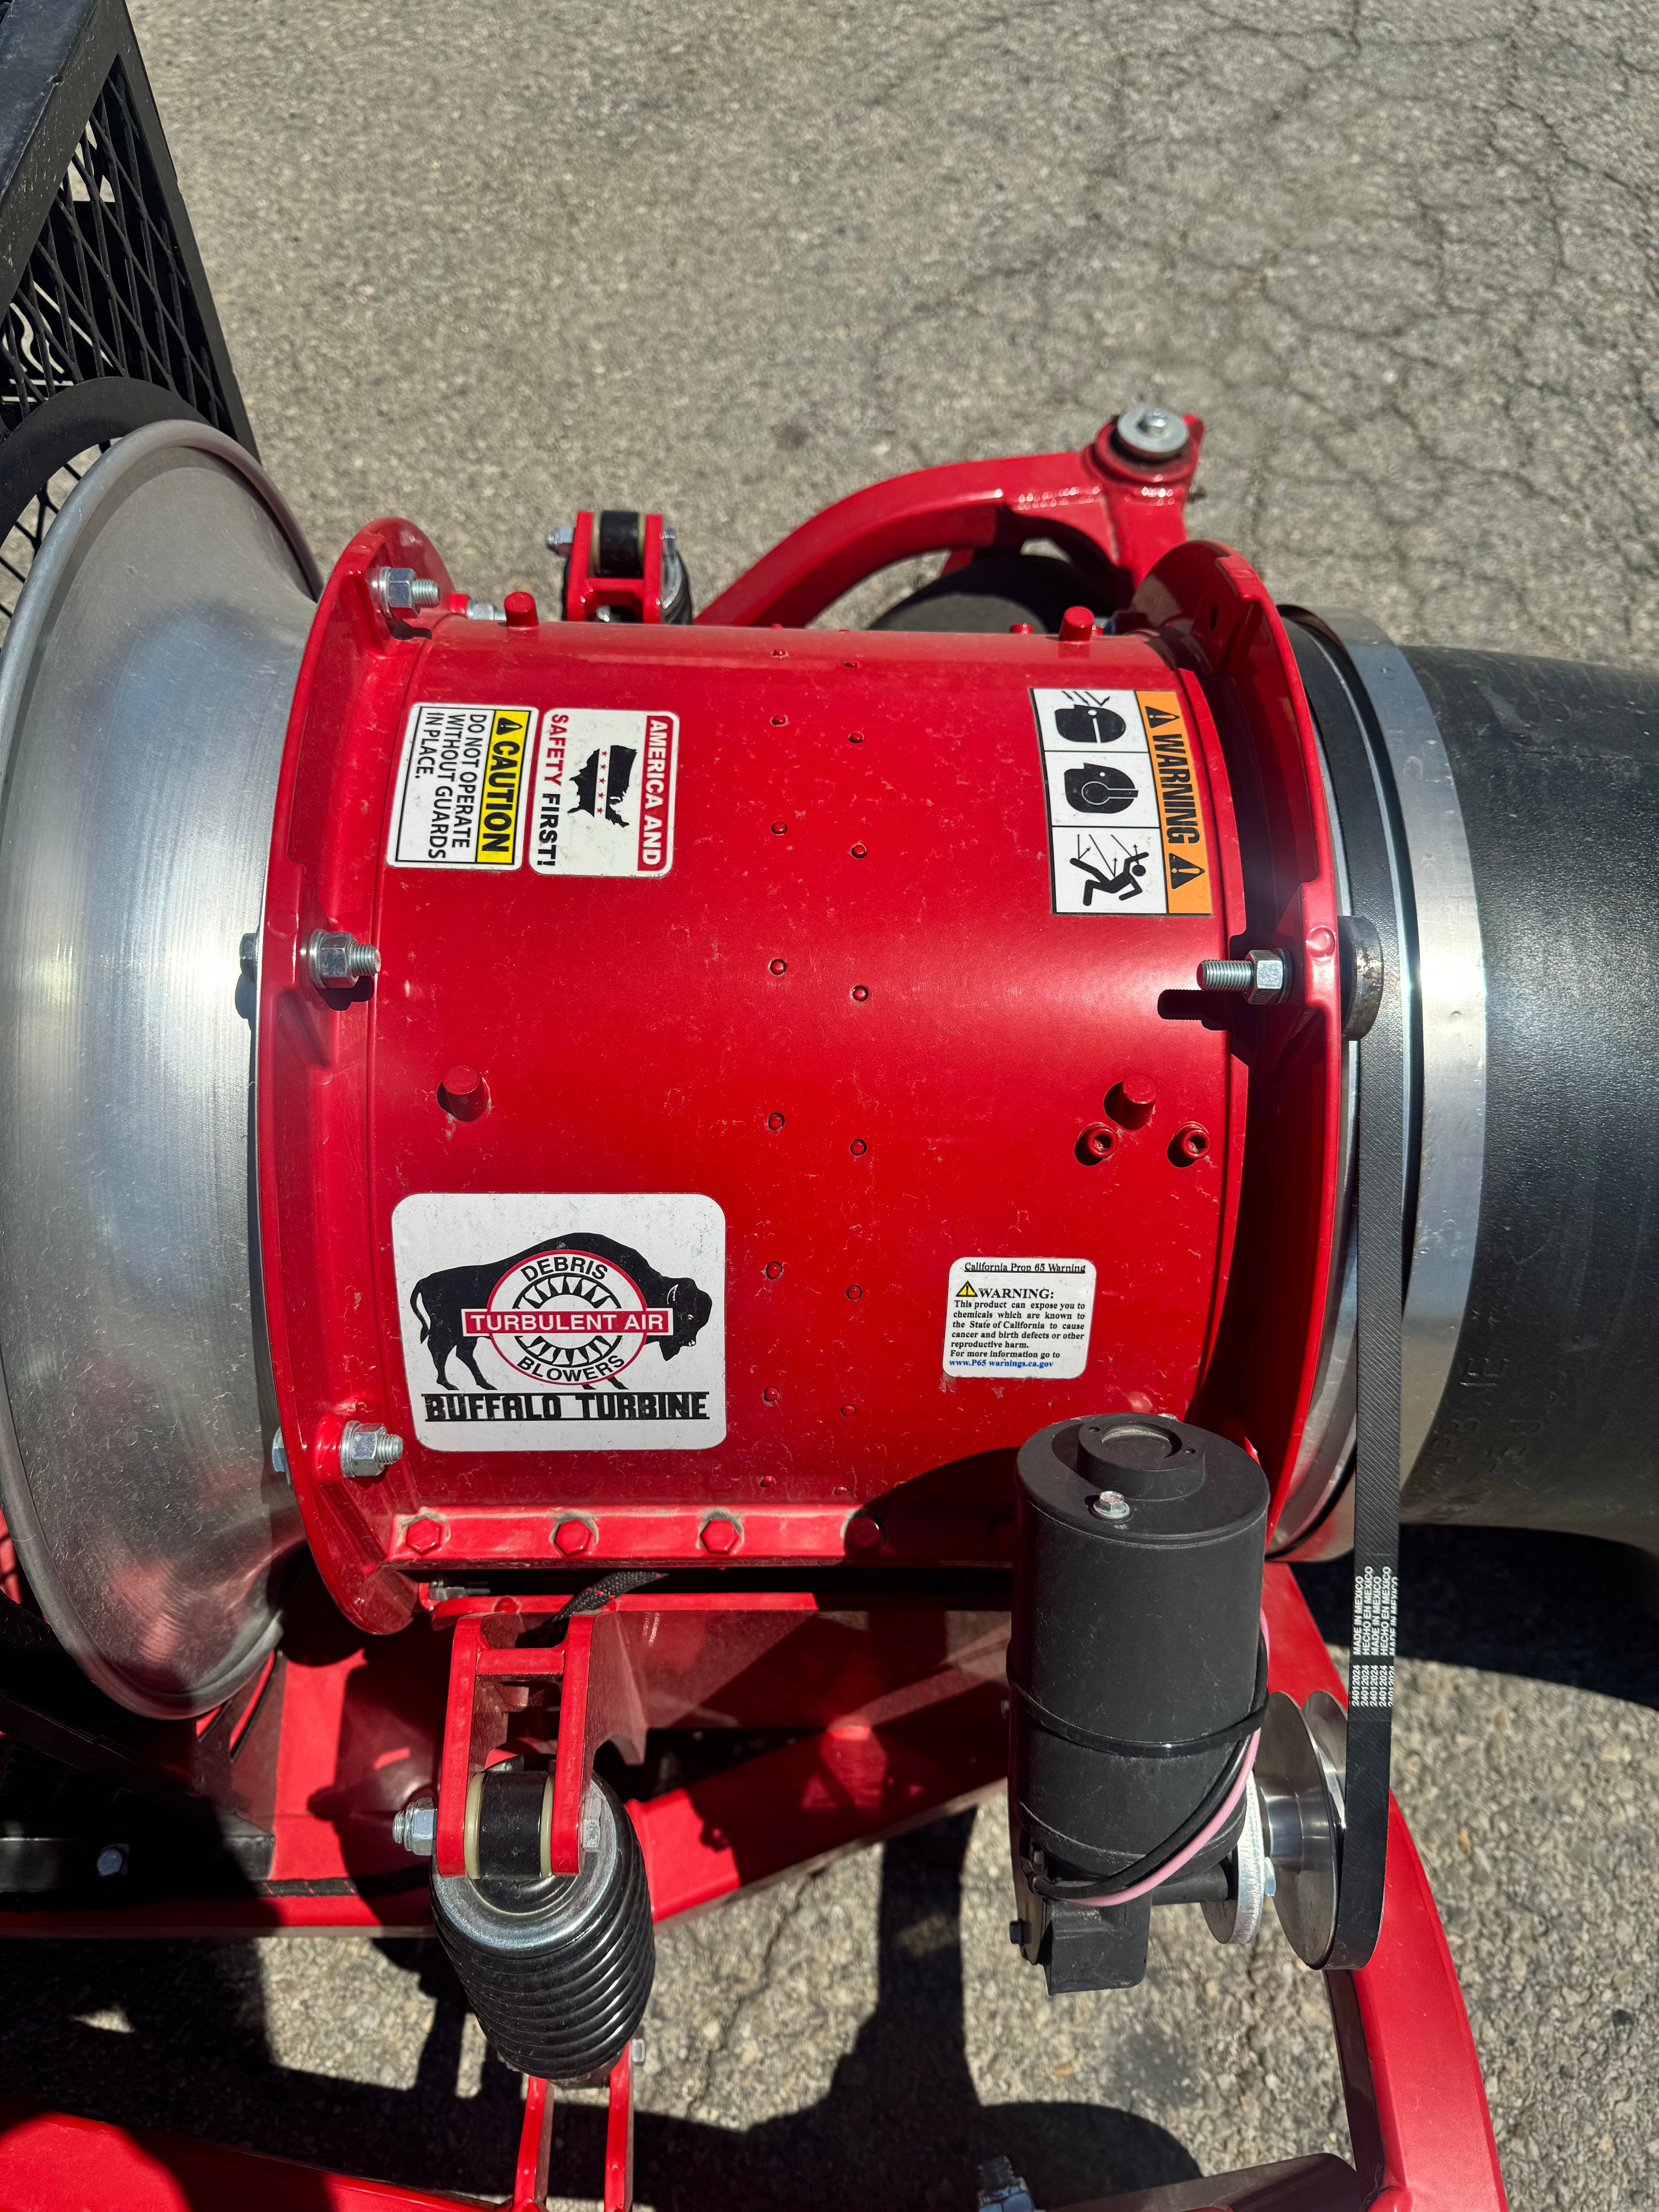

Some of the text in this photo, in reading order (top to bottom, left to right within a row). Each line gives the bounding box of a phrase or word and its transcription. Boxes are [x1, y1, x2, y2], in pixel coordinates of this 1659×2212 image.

[416, 713, 444, 778] IN PLACE.
[429, 715, 465, 858] WITHOUT GUARDS
[452, 715, 486, 847] DO NOT OPERATE
[482, 741, 520, 852] CAUTION
[537, 715, 569, 866] SAFETY FIRST!
[643, 720, 667, 864] AMERICA AND
[1153, 734, 1199, 843] WARNING
[521, 1256, 608, 1282] DEBRIS
[965, 1262, 1007, 1272] California
[1035, 1264, 1045, 1273] 65
[1048, 1264, 1086, 1274] Warning
[974, 1301, 1007, 1309] product
[979, 1288, 1053, 1298] WARNING:
[471, 1315, 663, 1330] TURBULENT AIR
[951, 1341, 1002, 1349] reproductive
[989, 1359, 1053, 1368] warnings.ca.gov
[517, 1356, 624, 1382] BLOWERS
[425, 1392, 710, 1420] BUFFALO TURBINE
[1353, 1576, 1364, 1656] MADE IN MEXICO
[1362, 1566, 1373, 1656] HECHO EN MEXICO
[1371, 1576, 1381, 1656] MADE IN MEXICO
[1380, 1566, 1392, 1656] HECHO EN MEXICO
[1351, 1665, 1360, 1707] 24012024
[1360, 1665, 1370, 1707] 24012024
[1370, 1665, 1379, 1707] 24012024
[1379, 1665, 1388, 1707] 24012024
